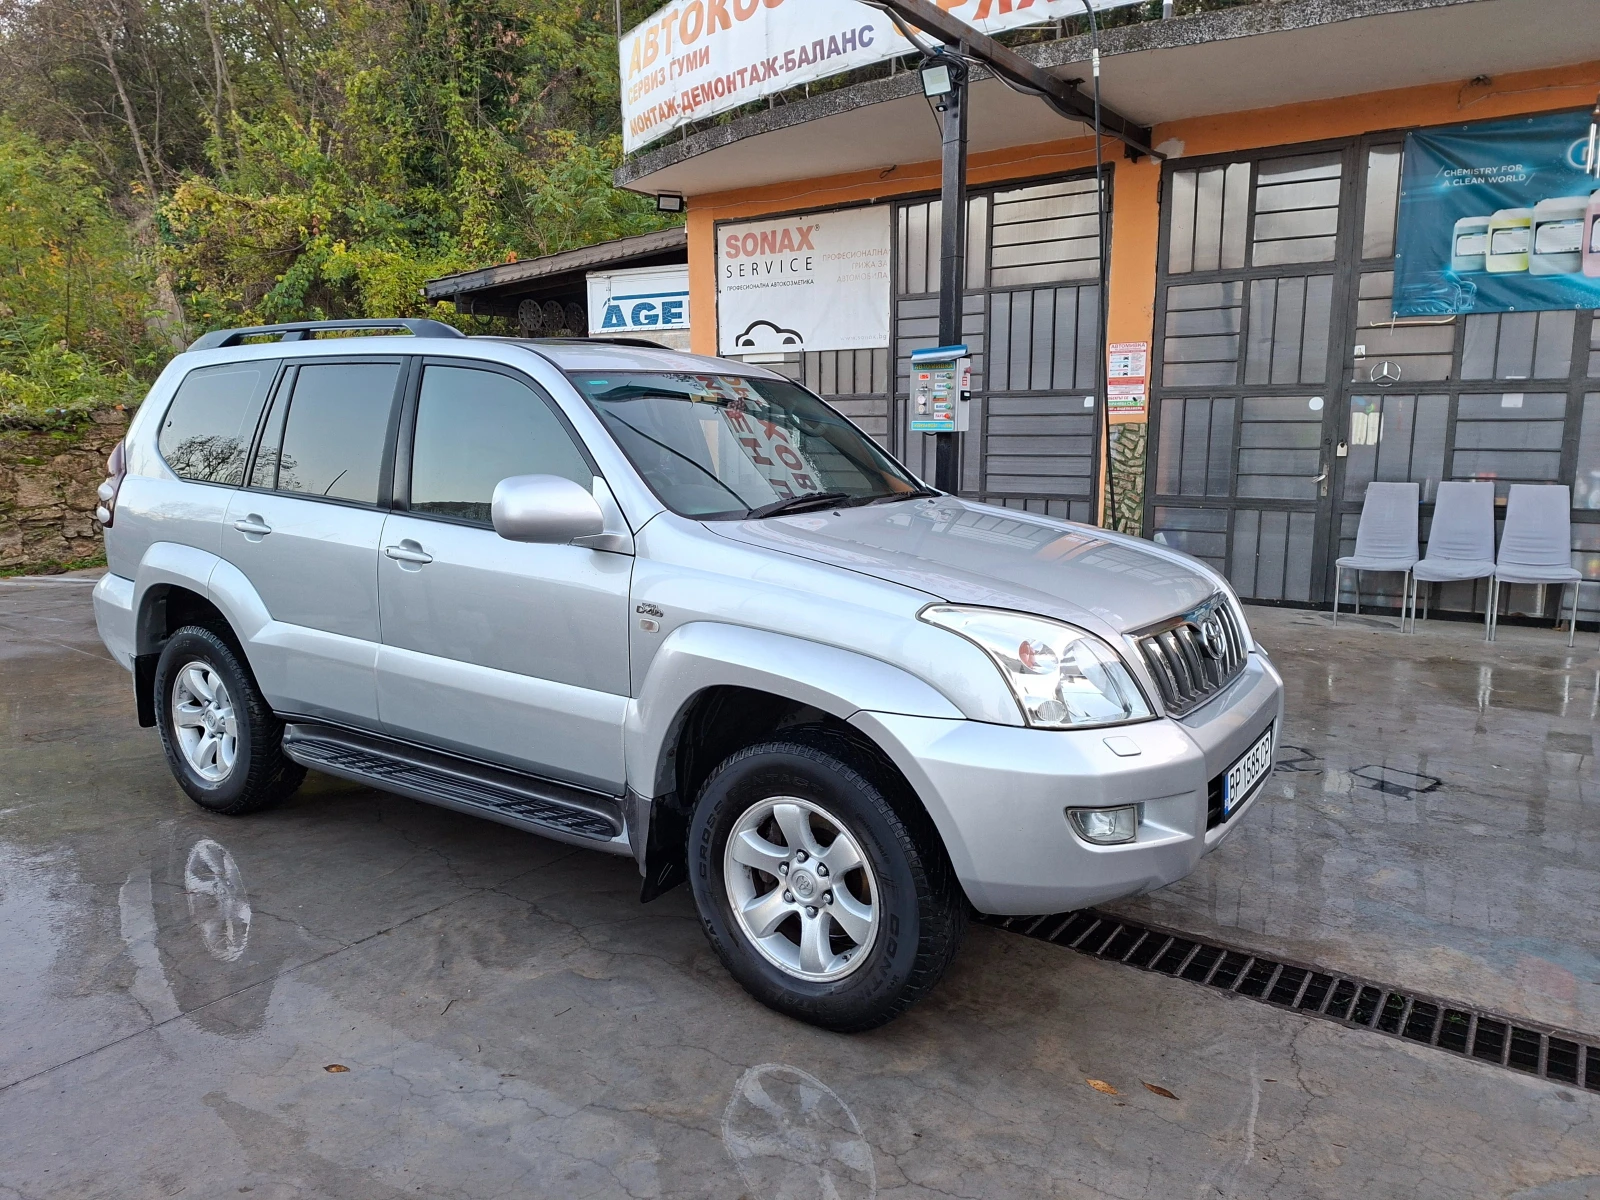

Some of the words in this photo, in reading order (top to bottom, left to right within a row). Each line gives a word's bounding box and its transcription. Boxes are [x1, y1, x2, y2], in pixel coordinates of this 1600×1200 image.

[628, 69, 666, 105] СЕРВИЗ
[669, 45, 710, 81] ГУМИ
[1444, 166, 1499, 177] CHEMISTRY
[1501, 163, 1523, 173] FOR
[1453, 177, 1485, 187] CLEAN
[1487, 173, 1527, 184] WORLD
[726, 256, 813, 279] SERVICE
[726, 282, 770, 292] ПРОФЕСИОНАЛНА
[770, 278, 815, 288] АВТОКОЗМЕТИКА
[601, 300, 690, 328] AGE
